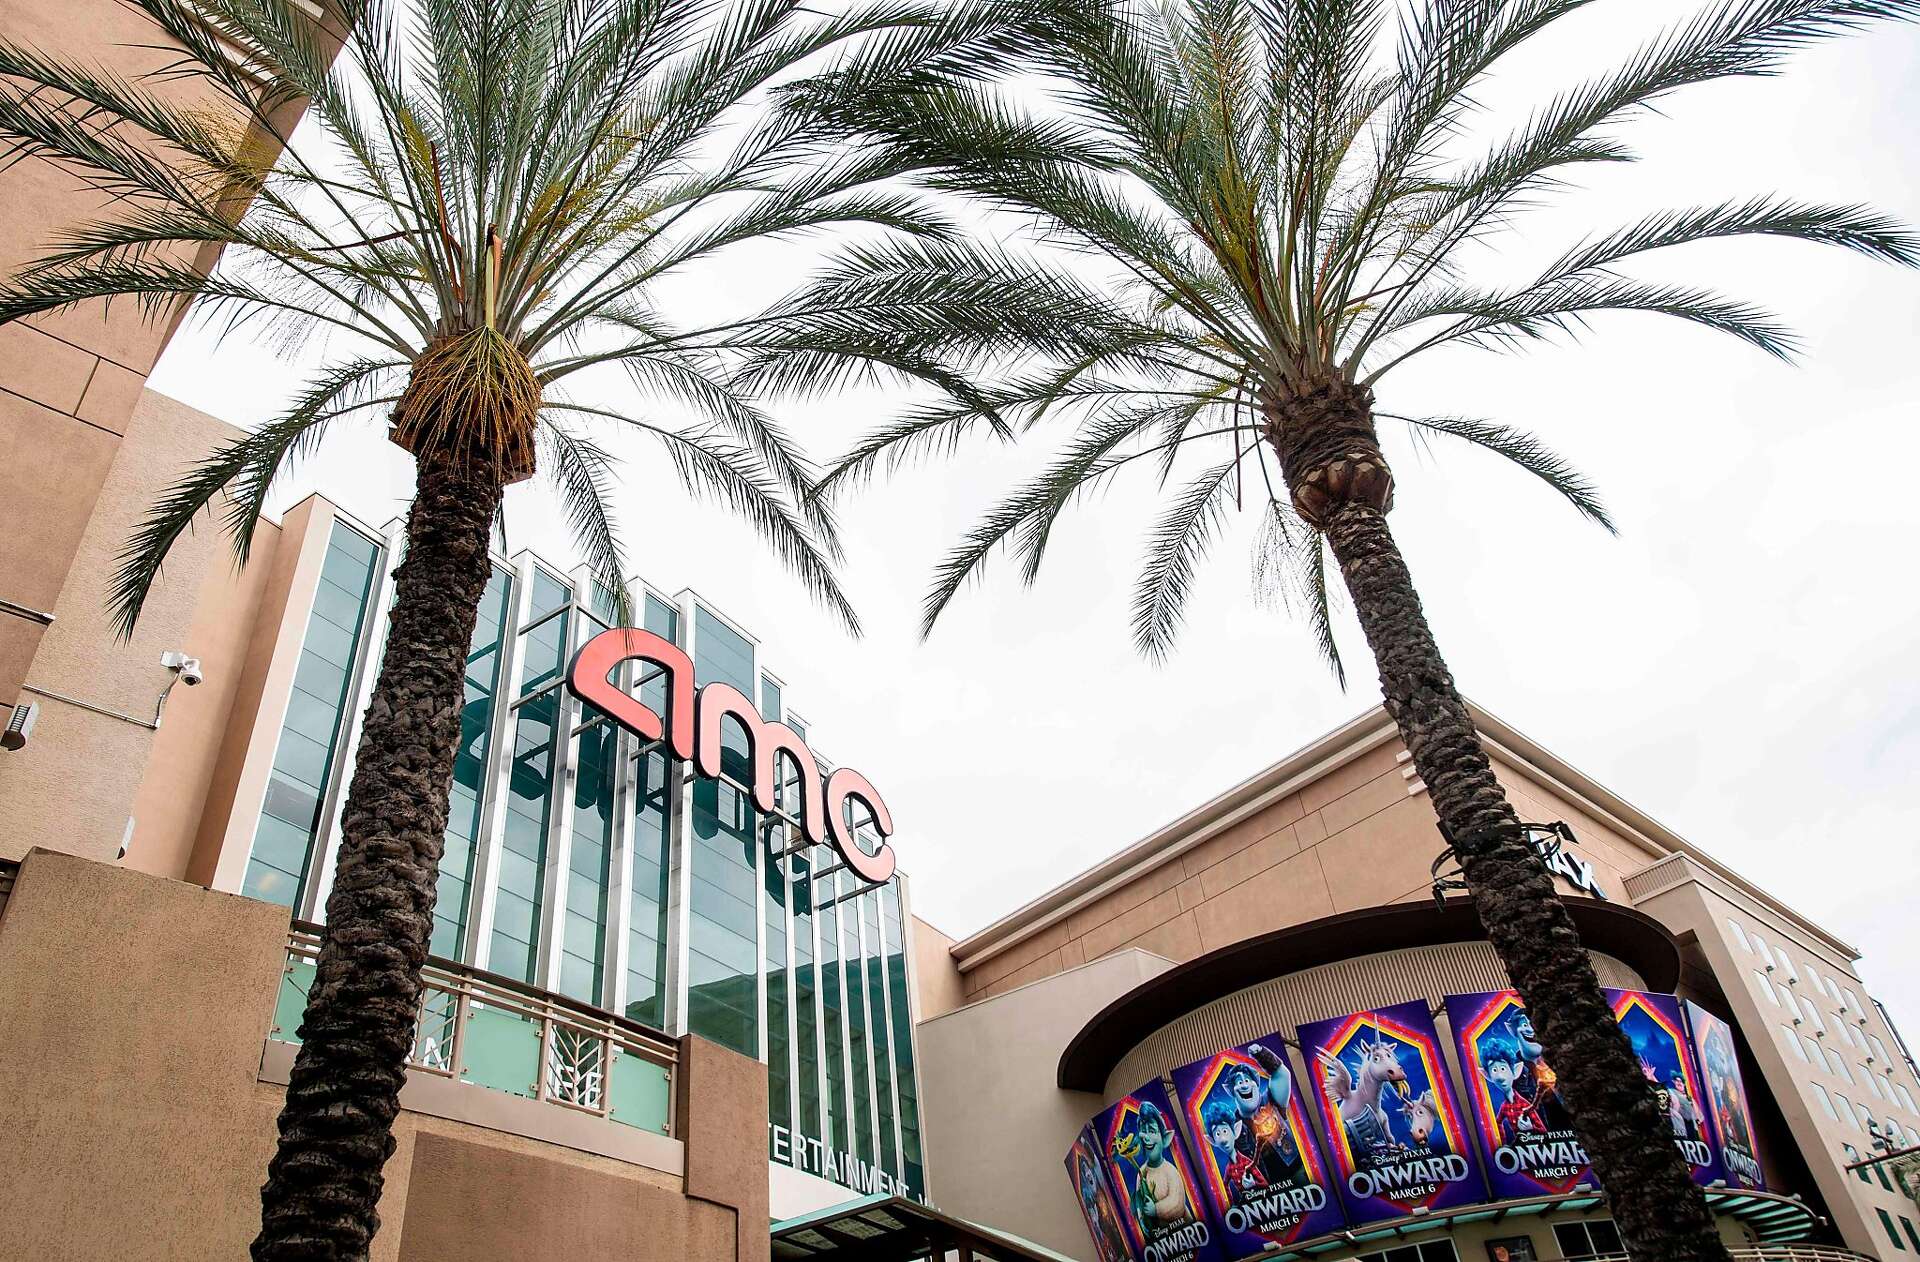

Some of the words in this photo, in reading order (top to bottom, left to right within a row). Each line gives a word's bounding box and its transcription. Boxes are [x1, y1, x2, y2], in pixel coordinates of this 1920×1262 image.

[566, 627, 896, 884] amc
[1516, 1131, 1545, 1142] Disney
[1547, 1130, 1574, 1139] PIXAR
[768, 1123, 909, 1199] ERTAINMENT
[1371, 1154, 1400, 1165] Disney
[1403, 1147, 1432, 1159] PIXAR
[1495, 1141, 1591, 1174] ONWAR
[1348, 1154, 1469, 1198] ONWARD
[1534, 1167, 1568, 1179] MARCH
[1571, 1166, 1578, 1174] 6
[1242, 1189, 1266, 1200] Disney
[1269, 1179, 1294, 1192] PIXAR
[1390, 1186, 1425, 1200] MARCH
[1428, 1184, 1436, 1192] 6
[1225, 1183, 1327, 1233] ONWARD
[1260, 1217, 1291, 1233] MARCH
[1292, 1214, 1300, 1223] 6
[1188, 1251, 1194, 1259] 6
